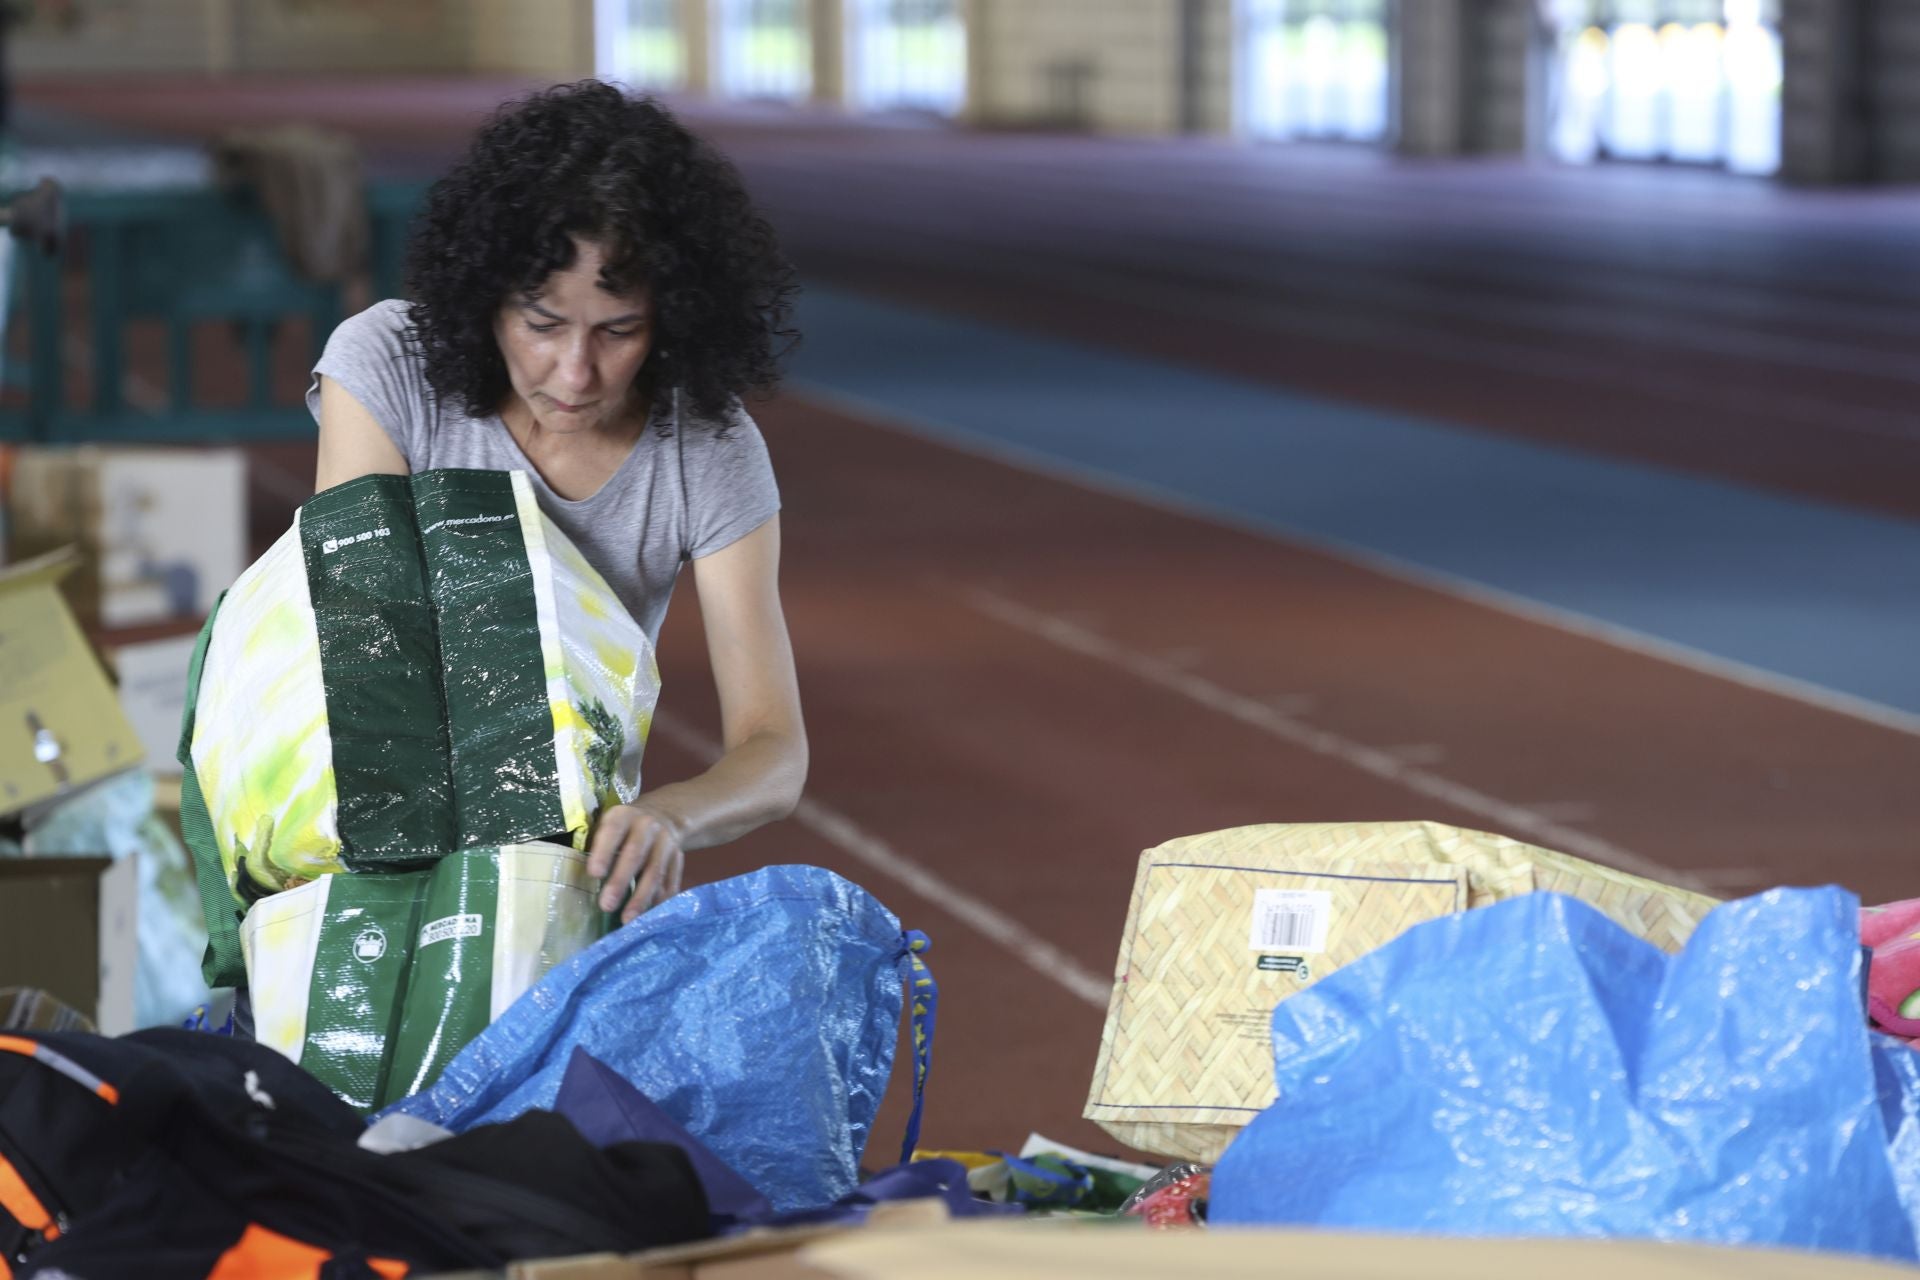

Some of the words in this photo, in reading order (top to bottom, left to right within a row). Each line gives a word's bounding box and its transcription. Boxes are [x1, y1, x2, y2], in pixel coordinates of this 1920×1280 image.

[338, 536, 355, 548] 900
[356, 531, 373, 543] 500
[374, 527, 391, 538] 103
[430, 916, 477, 931] MERCADNA
